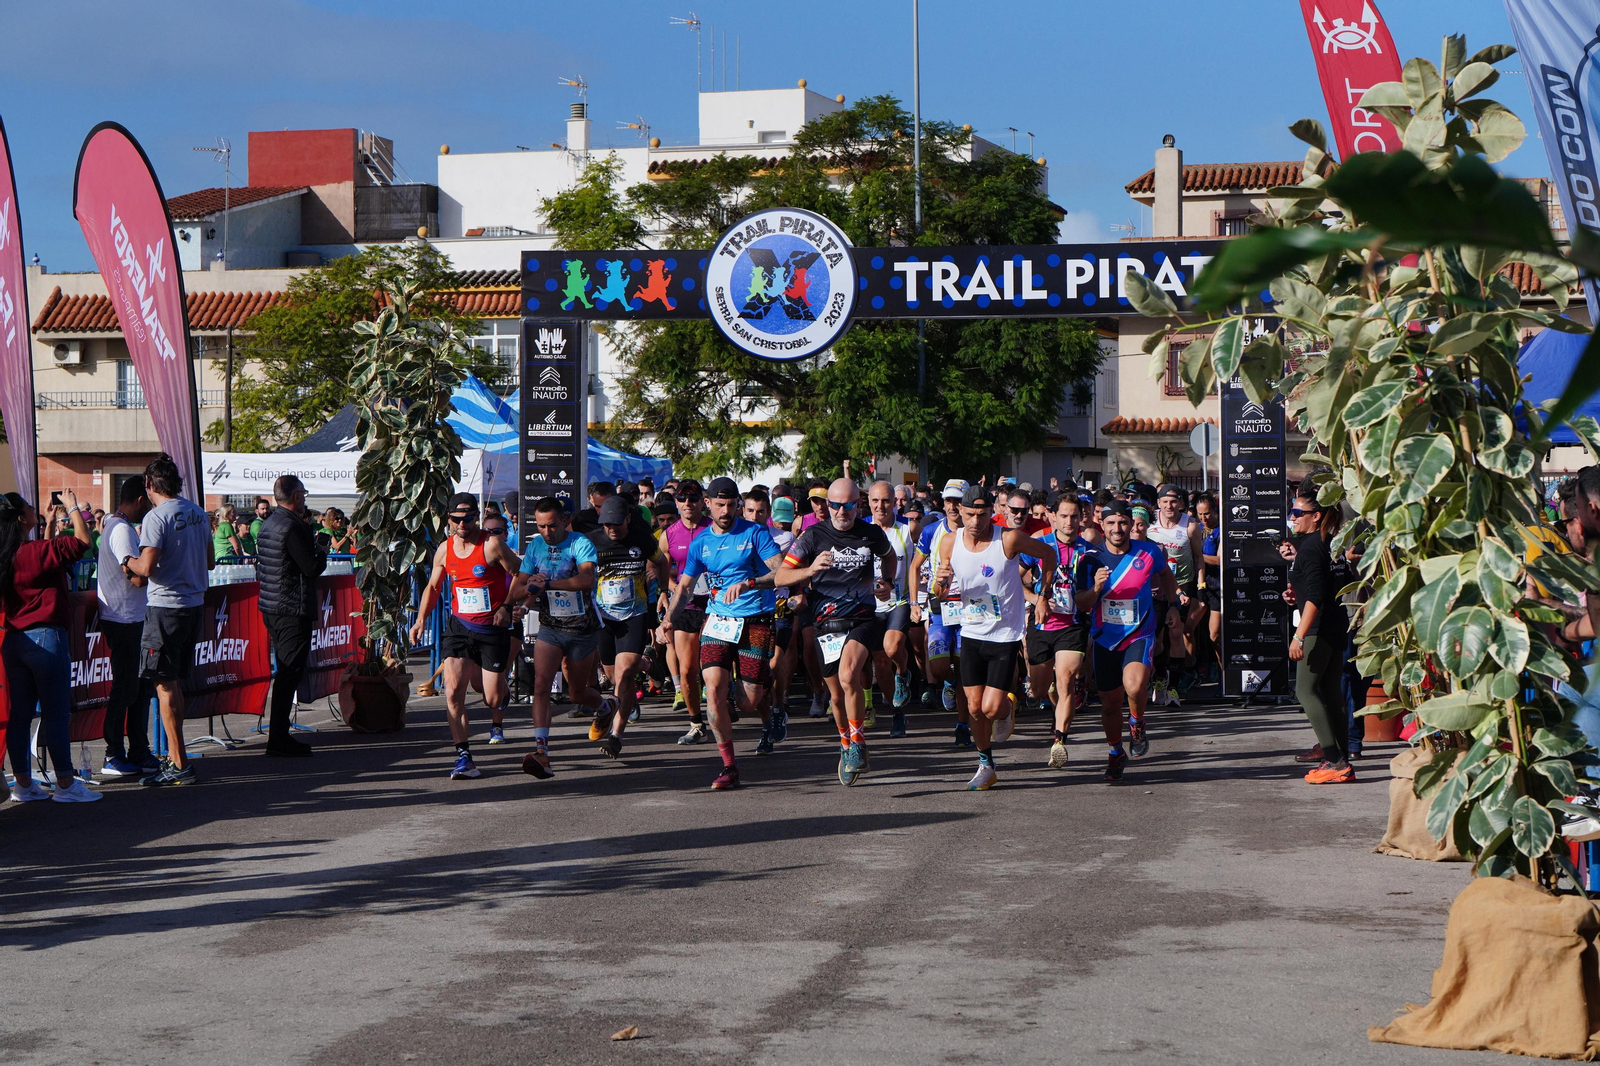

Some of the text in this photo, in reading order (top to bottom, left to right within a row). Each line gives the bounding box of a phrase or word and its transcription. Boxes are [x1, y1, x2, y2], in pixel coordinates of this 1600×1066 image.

[719, 216, 844, 269] TRAIL PIRATA
[893, 259, 1047, 302] TRAIL
[823, 292, 846, 328] 2023
[715, 286, 812, 351] SIERRA SAN CRISTOBAL
[533, 391, 568, 400] INAUTO
[528, 423, 572, 431] LIBERTIUM
[1235, 424, 1272, 433] INAUTO
[243, 467, 316, 482] Equipaciones
[1262, 467, 1279, 475] CAV
[531, 473, 548, 481] CAV
[1259, 575, 1279, 583] alpha
[608, 586, 625, 595] 519
[462, 595, 478, 604] 675
[554, 598, 572, 608] 906
[969, 604, 988, 614] 869
[1108, 607, 1127, 616] 893
[712, 622, 731, 633] 676
[310, 624, 352, 651] EAMERGY
[828, 640, 842, 652] 905
[194, 638, 250, 667] TEAMERGY
